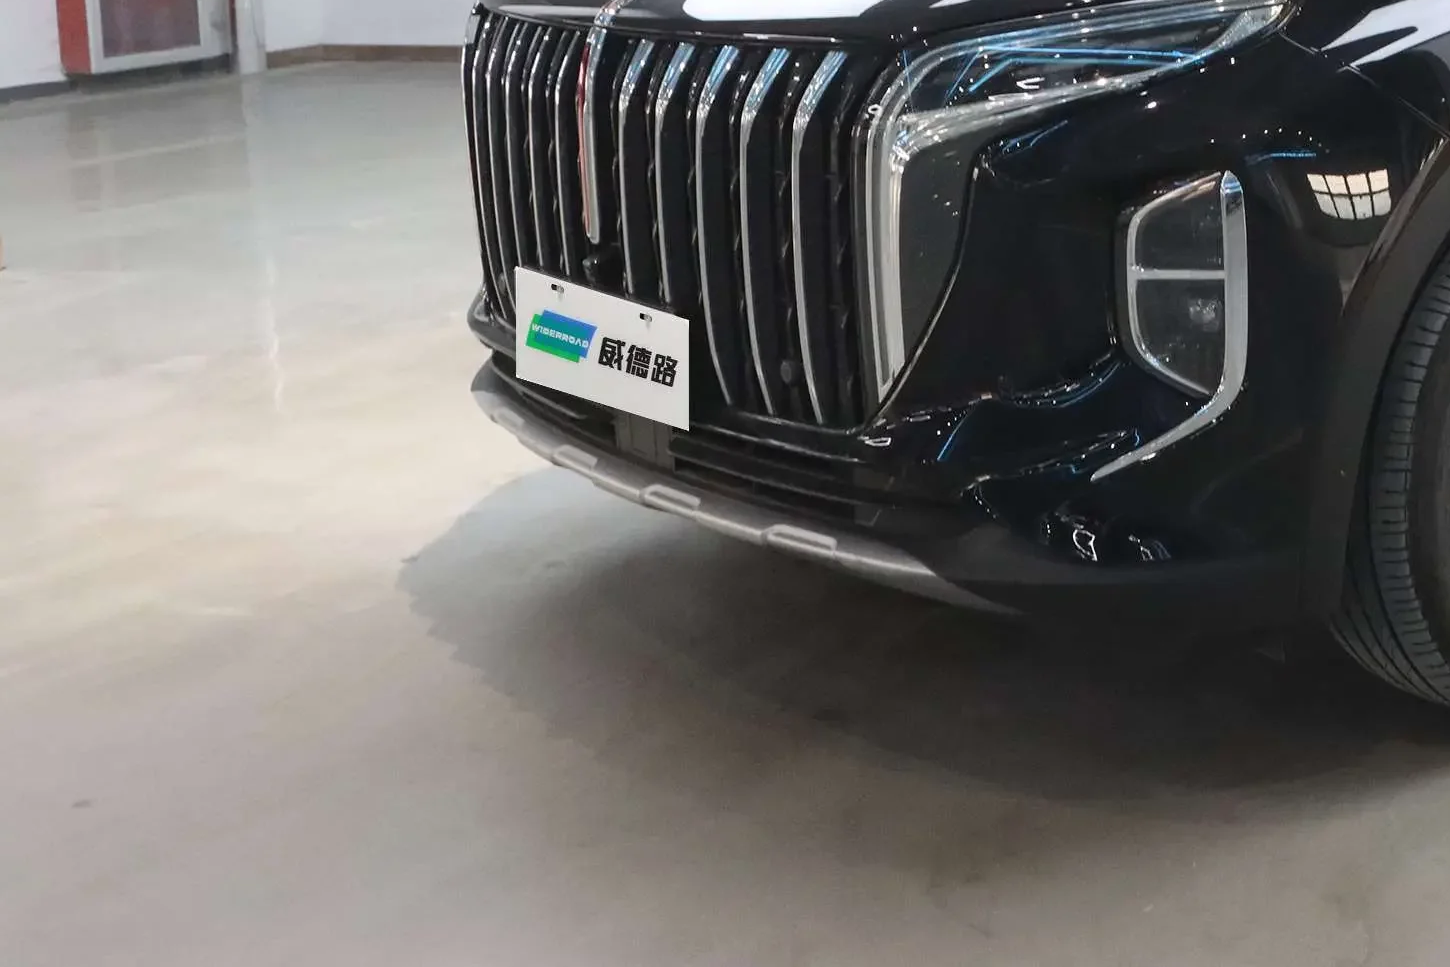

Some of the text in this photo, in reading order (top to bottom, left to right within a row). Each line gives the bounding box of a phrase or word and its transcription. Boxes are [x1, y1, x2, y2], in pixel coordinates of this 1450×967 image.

[531, 323, 589, 349] WIDERROAD
[598, 337, 678, 387] 威德路
